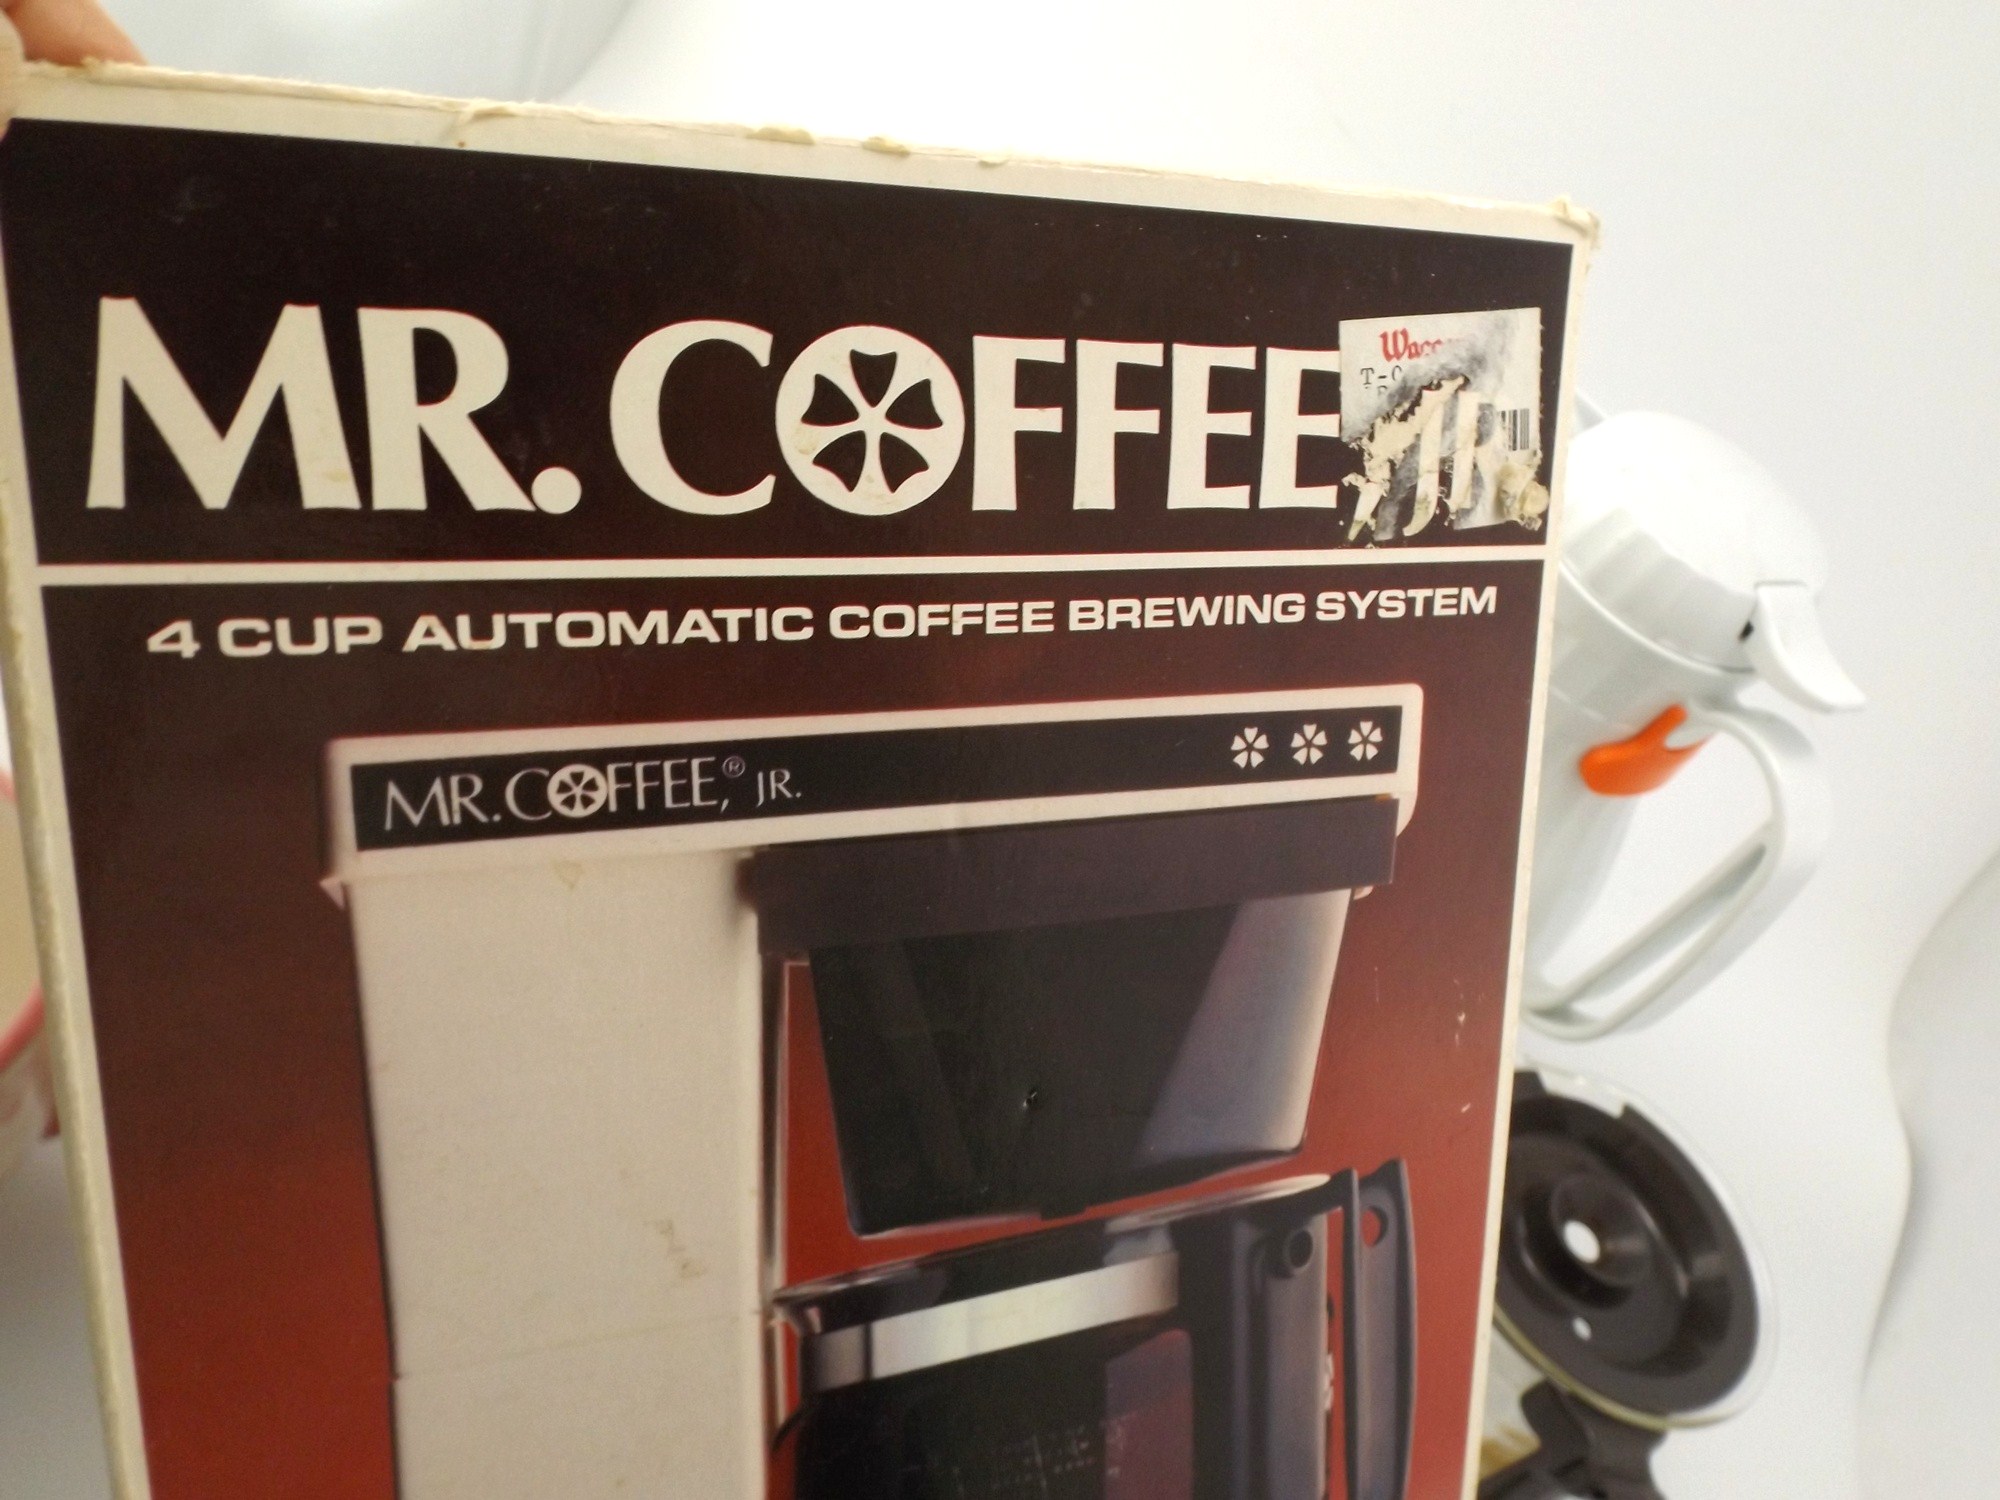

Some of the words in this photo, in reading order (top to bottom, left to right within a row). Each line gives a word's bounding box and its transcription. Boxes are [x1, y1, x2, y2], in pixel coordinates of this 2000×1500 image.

[86, 296, 582, 515] MR.
[147, 620, 201, 659] 4
[217, 616, 383, 658] CUP
[402, 606, 815, 652] AUTOMATIC
[829, 600, 1055, 640] COFFEE
[1068, 592, 1306, 632] BREWING
[1315, 585, 1498, 622] SYSTEM
[384, 773, 502, 831] MR.
[756, 768, 802, 808] JR.
